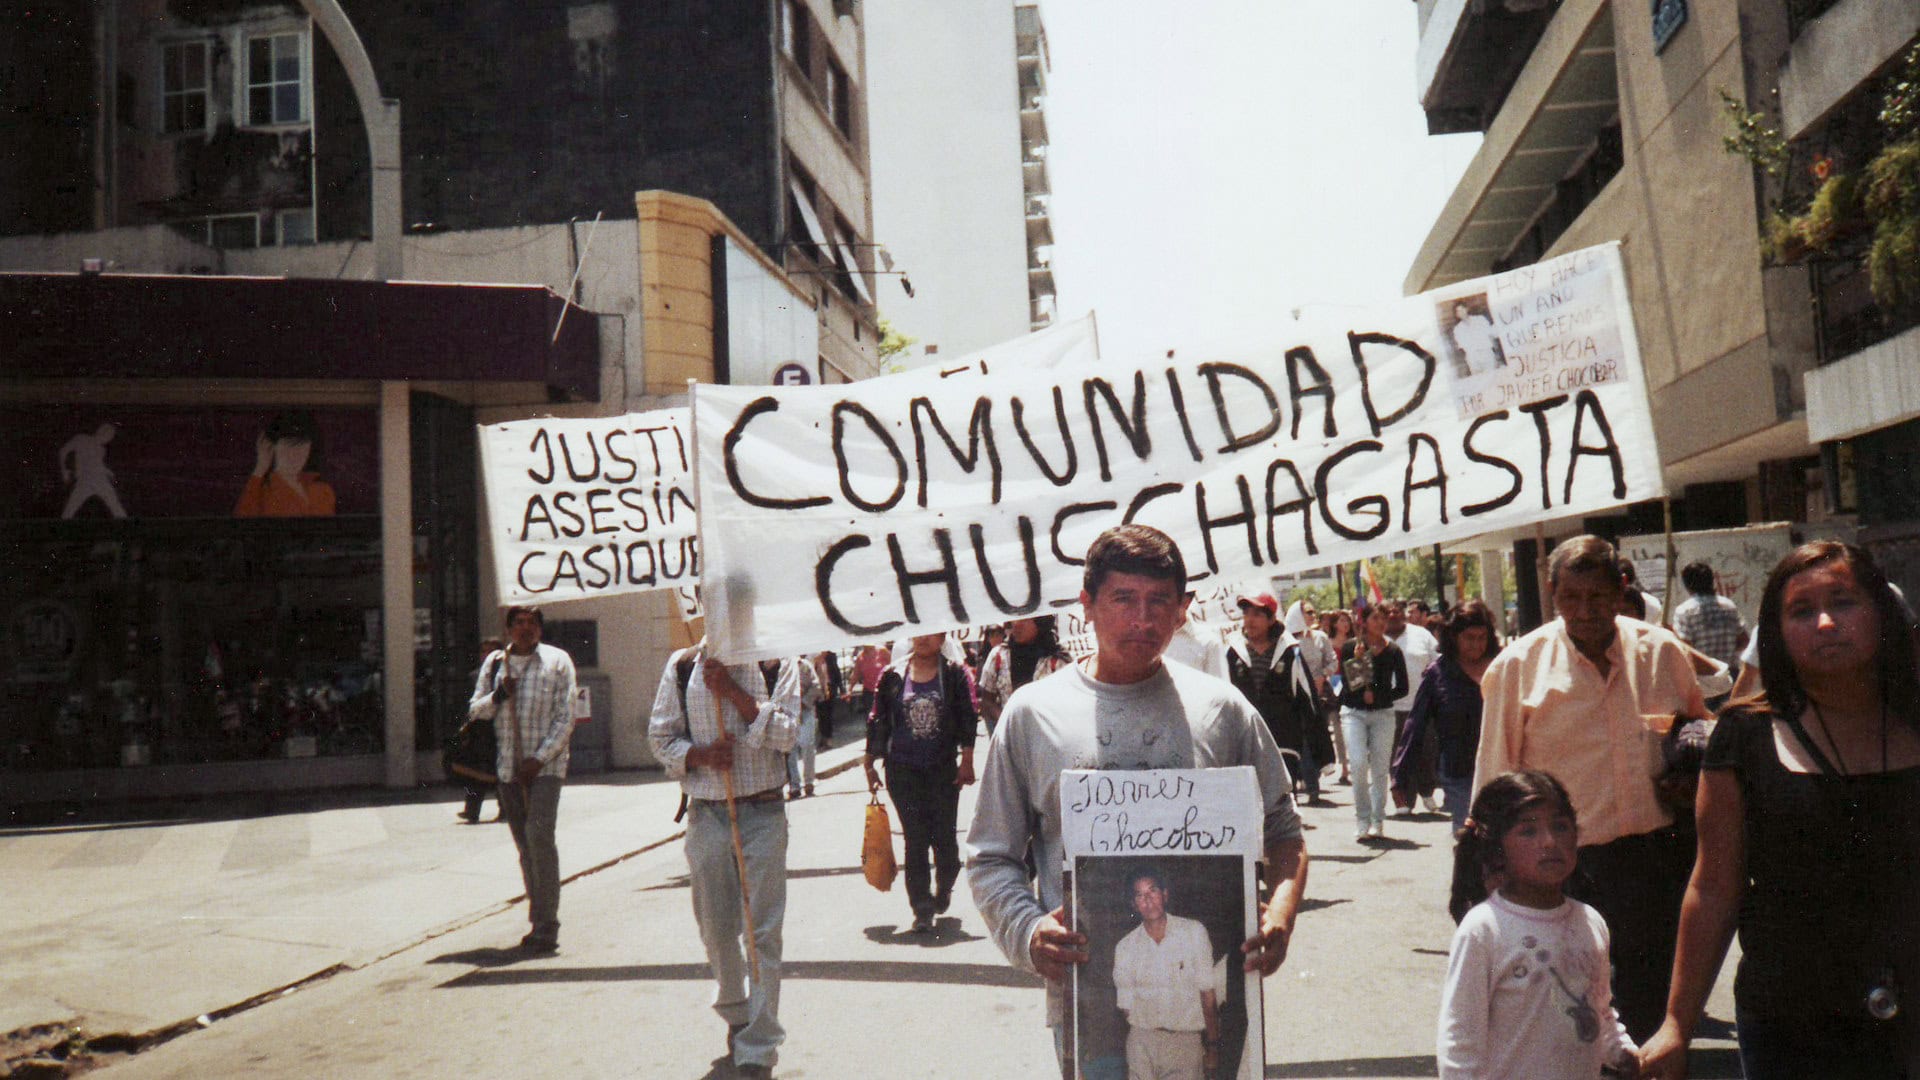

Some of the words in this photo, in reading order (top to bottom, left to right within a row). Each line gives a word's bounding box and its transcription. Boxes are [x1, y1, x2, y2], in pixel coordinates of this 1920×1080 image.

[1496, 268, 1535, 292] HOY
[1499, 303, 1524, 326] UN
[1509, 336, 1598, 378] JUSTICIA
[1496, 373, 1553, 406] JAVIER
[1556, 358, 1619, 391] CHOCOBAR
[1089, 804, 1236, 852] Chocobar
